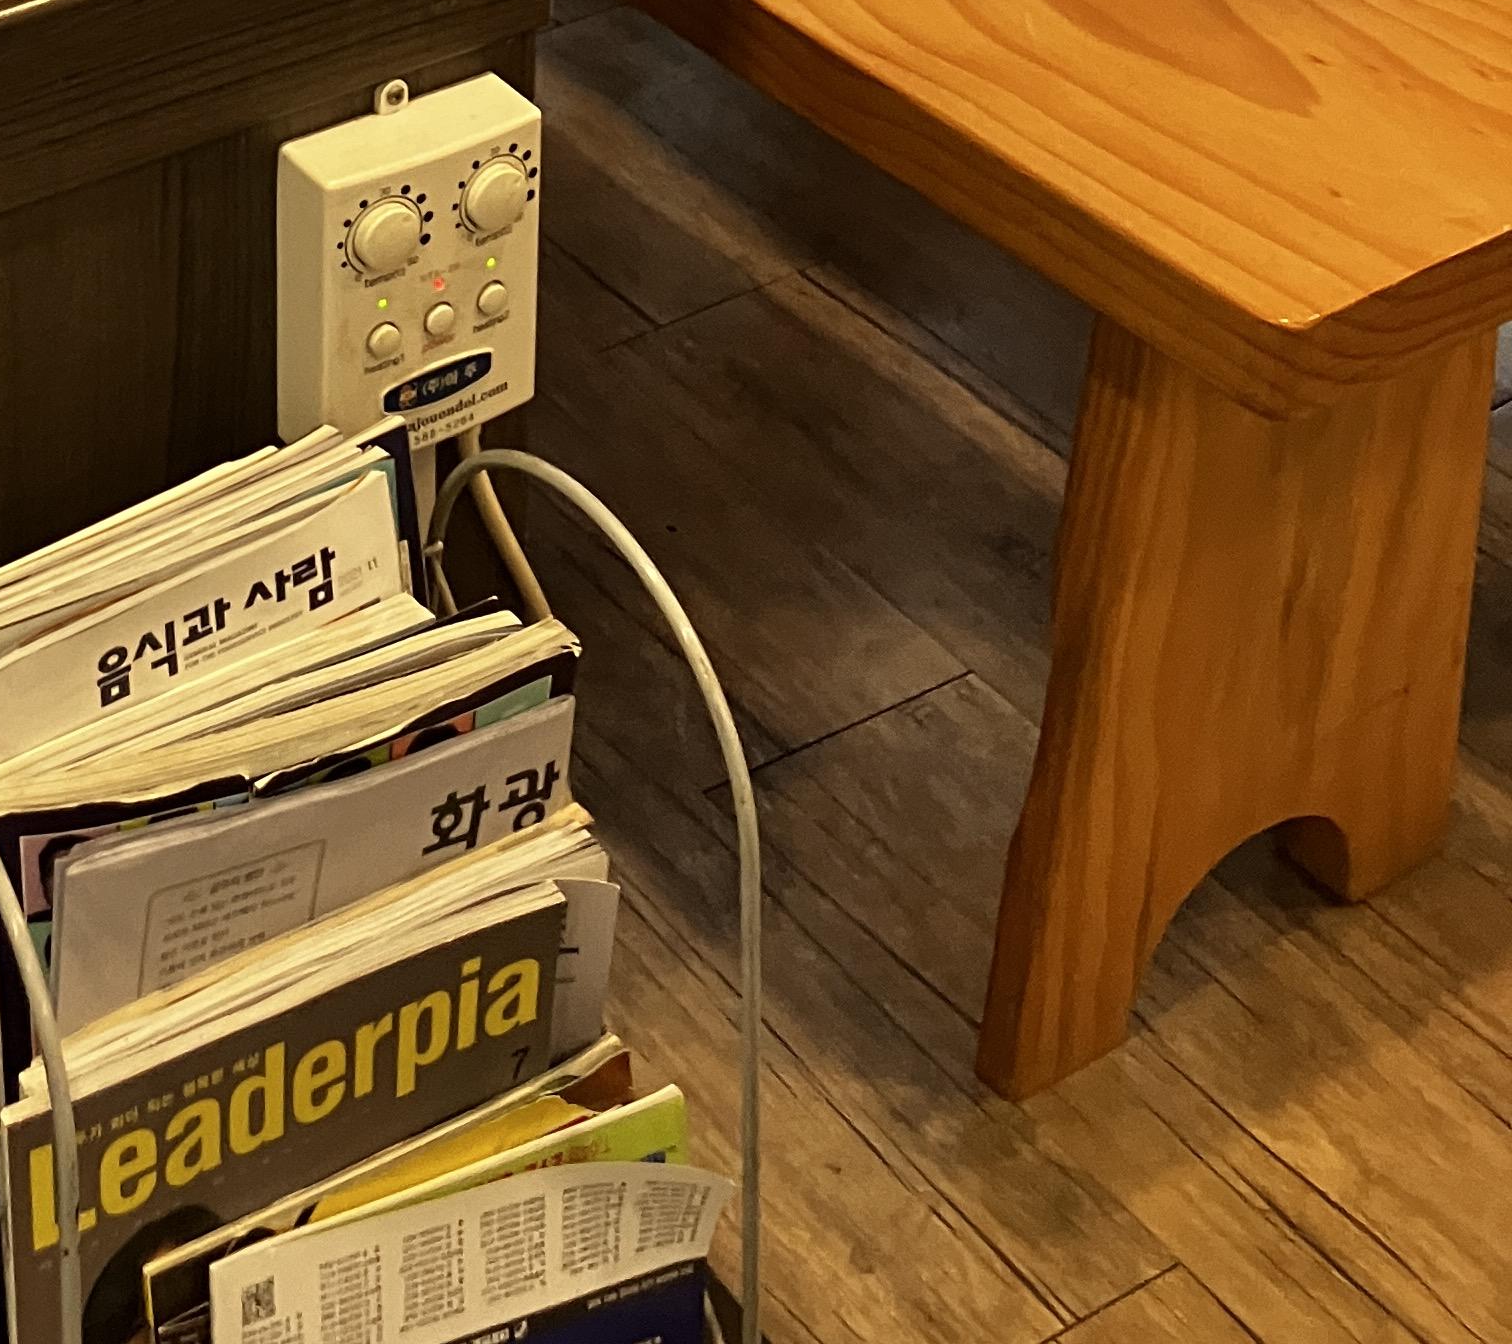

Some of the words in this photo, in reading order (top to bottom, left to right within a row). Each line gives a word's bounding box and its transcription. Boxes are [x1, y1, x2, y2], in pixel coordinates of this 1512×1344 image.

[96, 597, 231, 708] 음식과
[243, 546, 336, 612] 사람
[422, 759, 561, 856] 화광
[29, 955, 540, 1250] Leaderpia
